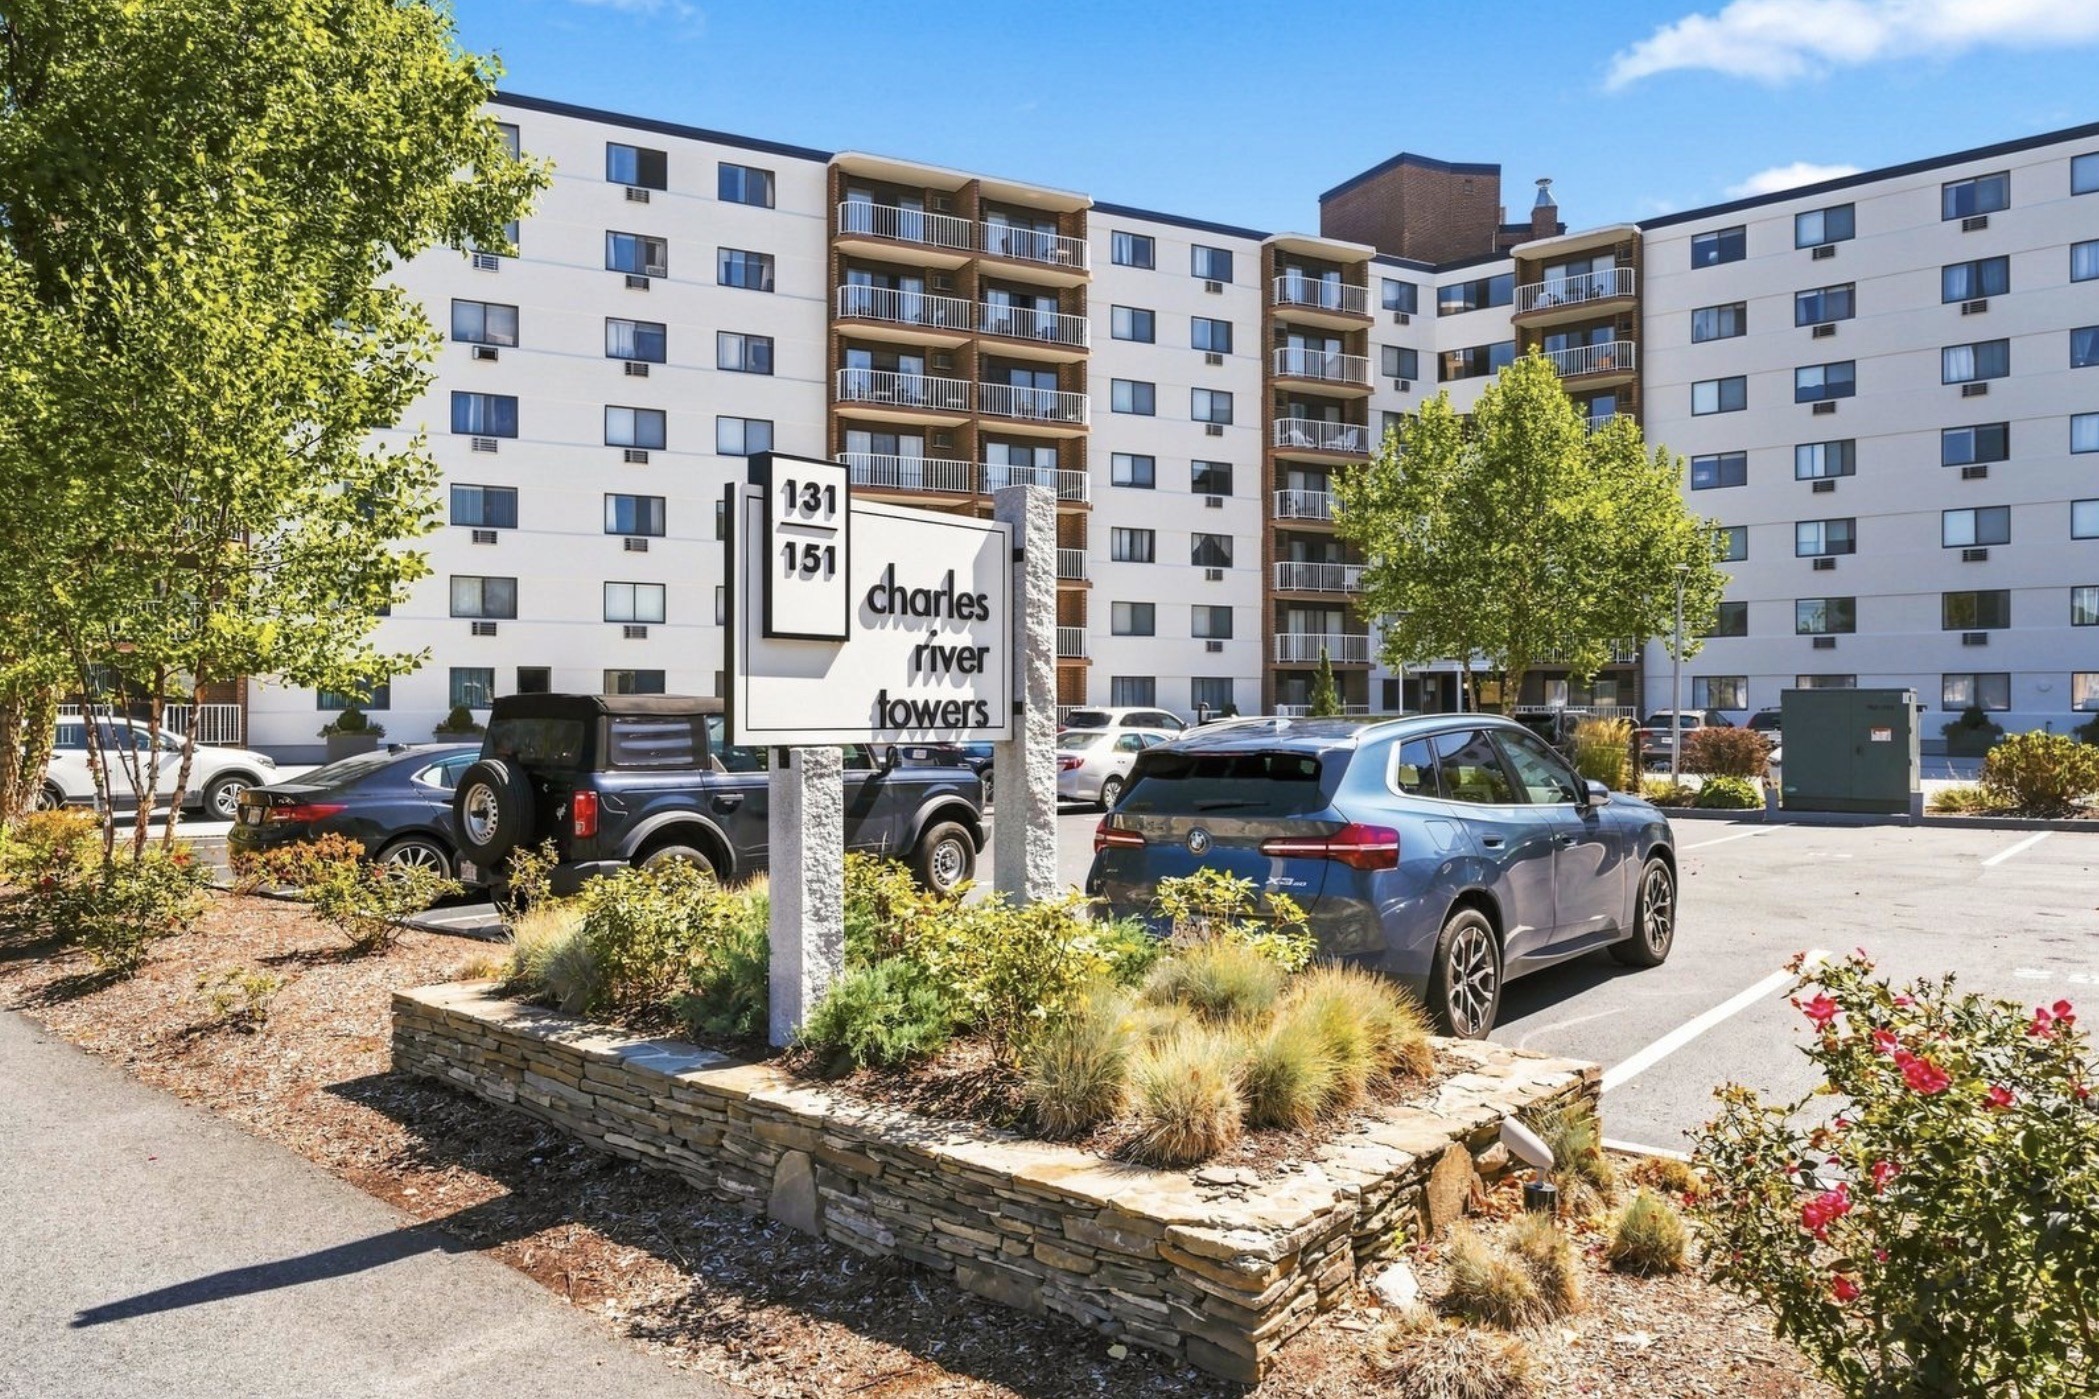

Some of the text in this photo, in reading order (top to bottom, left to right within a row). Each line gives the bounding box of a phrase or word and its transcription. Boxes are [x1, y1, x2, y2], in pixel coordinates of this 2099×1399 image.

[784, 478, 837, 514] 131
[784, 541, 836, 575] 151
[867, 563, 989, 621] charles
[915, 630, 989, 673] river
[878, 689, 989, 729] towers
